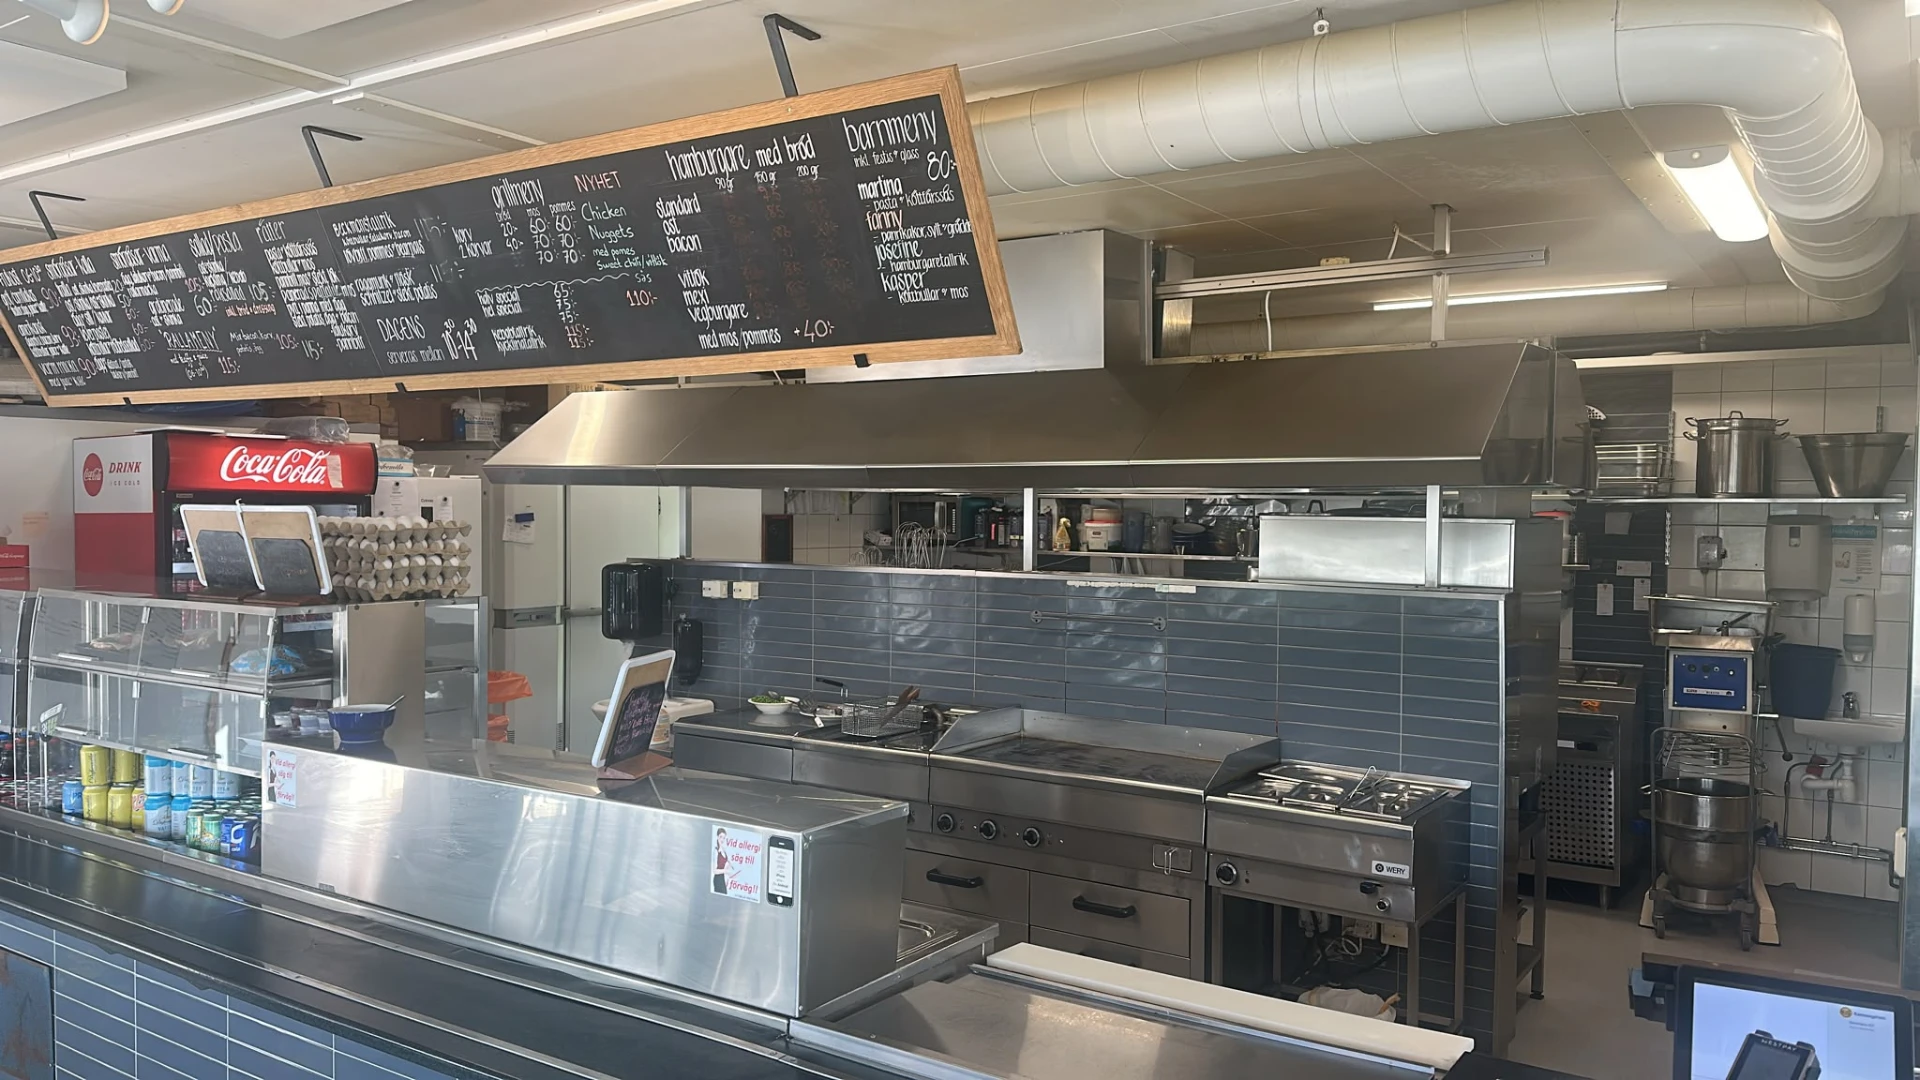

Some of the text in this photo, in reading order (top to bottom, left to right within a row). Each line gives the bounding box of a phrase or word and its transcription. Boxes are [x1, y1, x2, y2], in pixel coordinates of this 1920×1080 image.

[843, 110, 937, 152] barnmeny
[665, 132, 816, 181] hamburgare med bröd
[900, 148, 920, 165] glass
[573, 170, 622, 192] NYHET
[857, 174, 903, 200] martina
[491, 177, 545, 211] grillmeny
[526, 207, 541, 218] mos
[548, 200, 576, 217] pommes
[581, 201, 628, 222] Chicken
[656, 192, 701, 219] standard
[874, 197, 899, 212] pasta
[662, 217, 681, 235] ost
[865, 209, 903, 231] fanny
[255, 219, 286, 244] rätter
[451, 226, 474, 244] korv
[588, 224, 635, 244] Nuggets
[458, 244, 468, 259] 2
[468, 239, 493, 259] korvar
[592, 244, 609, 256] med
[666, 234, 702, 253] bacon
[874, 238, 923, 269] josefine
[890, 252, 969, 272] hamburgaretallrik
[880, 272, 926, 292] kasper
[950, 285, 969, 299] mos
[360, 287, 395, 307] schnitzel
[683, 287, 710, 307] mexi
[688, 303, 748, 330] vegburgare
[376, 314, 426, 342] DAGENS
[698, 329, 719, 350] med
[387, 347, 418, 365] serveras
[109, 461, 142, 474] DRINK
[220, 443, 331, 485] Coca-Cola
[726, 838, 761, 853] Vid allergi
[731, 854, 755, 865] säg till
[1386, 866, 1405, 875] WERY
